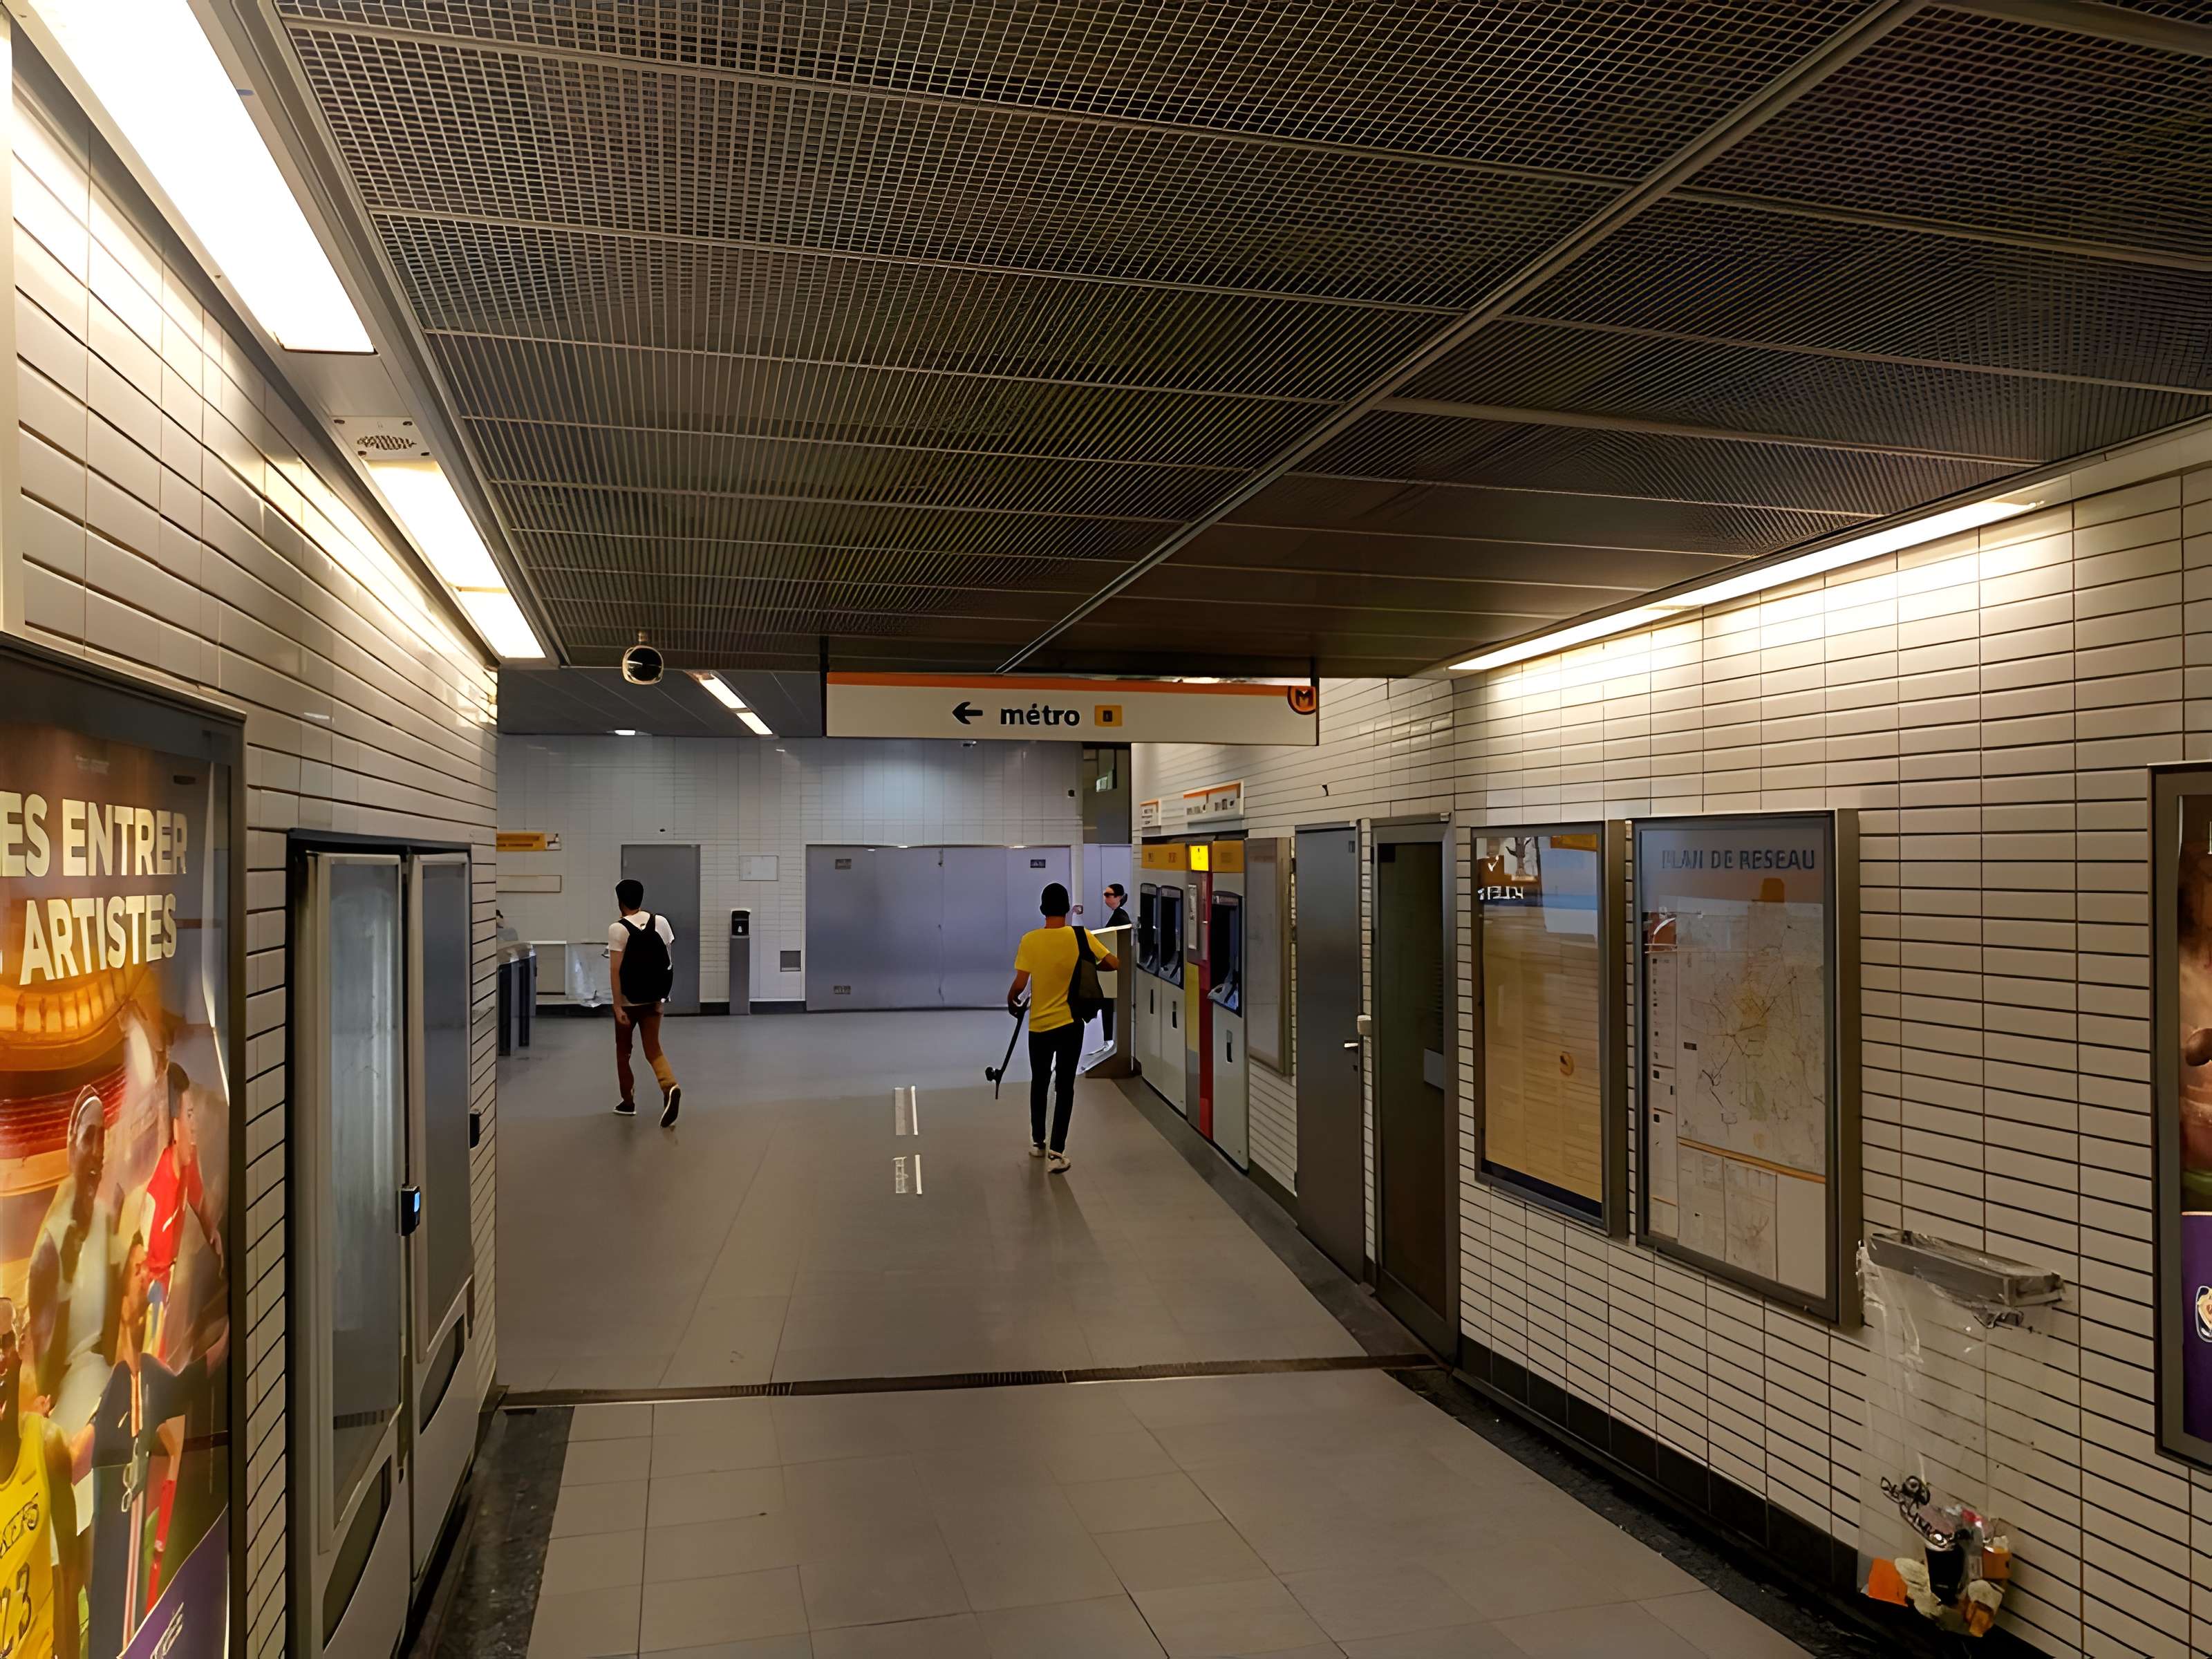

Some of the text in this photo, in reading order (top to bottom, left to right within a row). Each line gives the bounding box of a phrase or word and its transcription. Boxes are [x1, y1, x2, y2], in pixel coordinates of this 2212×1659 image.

[1000, 703, 1080, 727] métro
[62, 798, 188, 877] ENTRER
[1711, 850, 1734, 869] DE
[1739, 850, 1815, 870] RESEAU
[19, 893, 178, 986] ARTISTES
